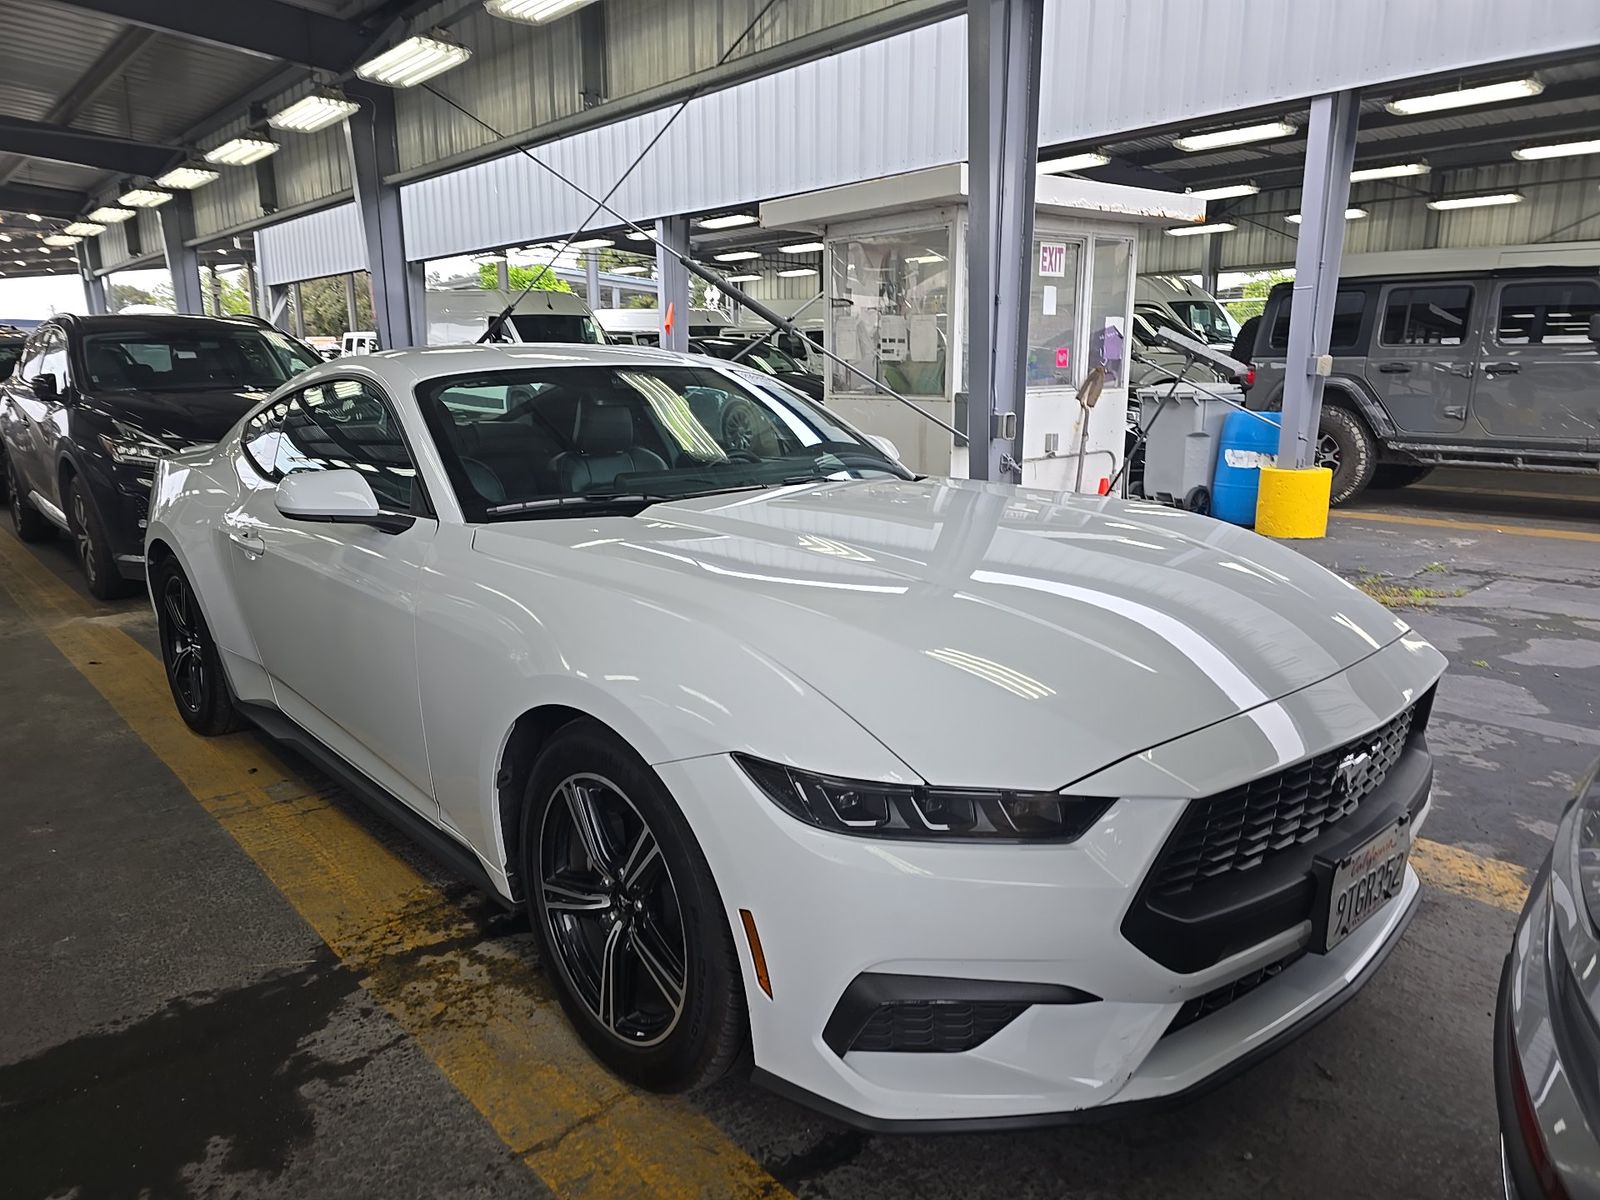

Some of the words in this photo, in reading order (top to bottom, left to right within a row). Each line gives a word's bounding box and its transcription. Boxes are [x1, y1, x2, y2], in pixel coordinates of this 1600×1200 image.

[1041, 246, 1064, 273] EXIT
[1350, 838, 1397, 878] California
[1334, 852, 1404, 936] 9TGR352
